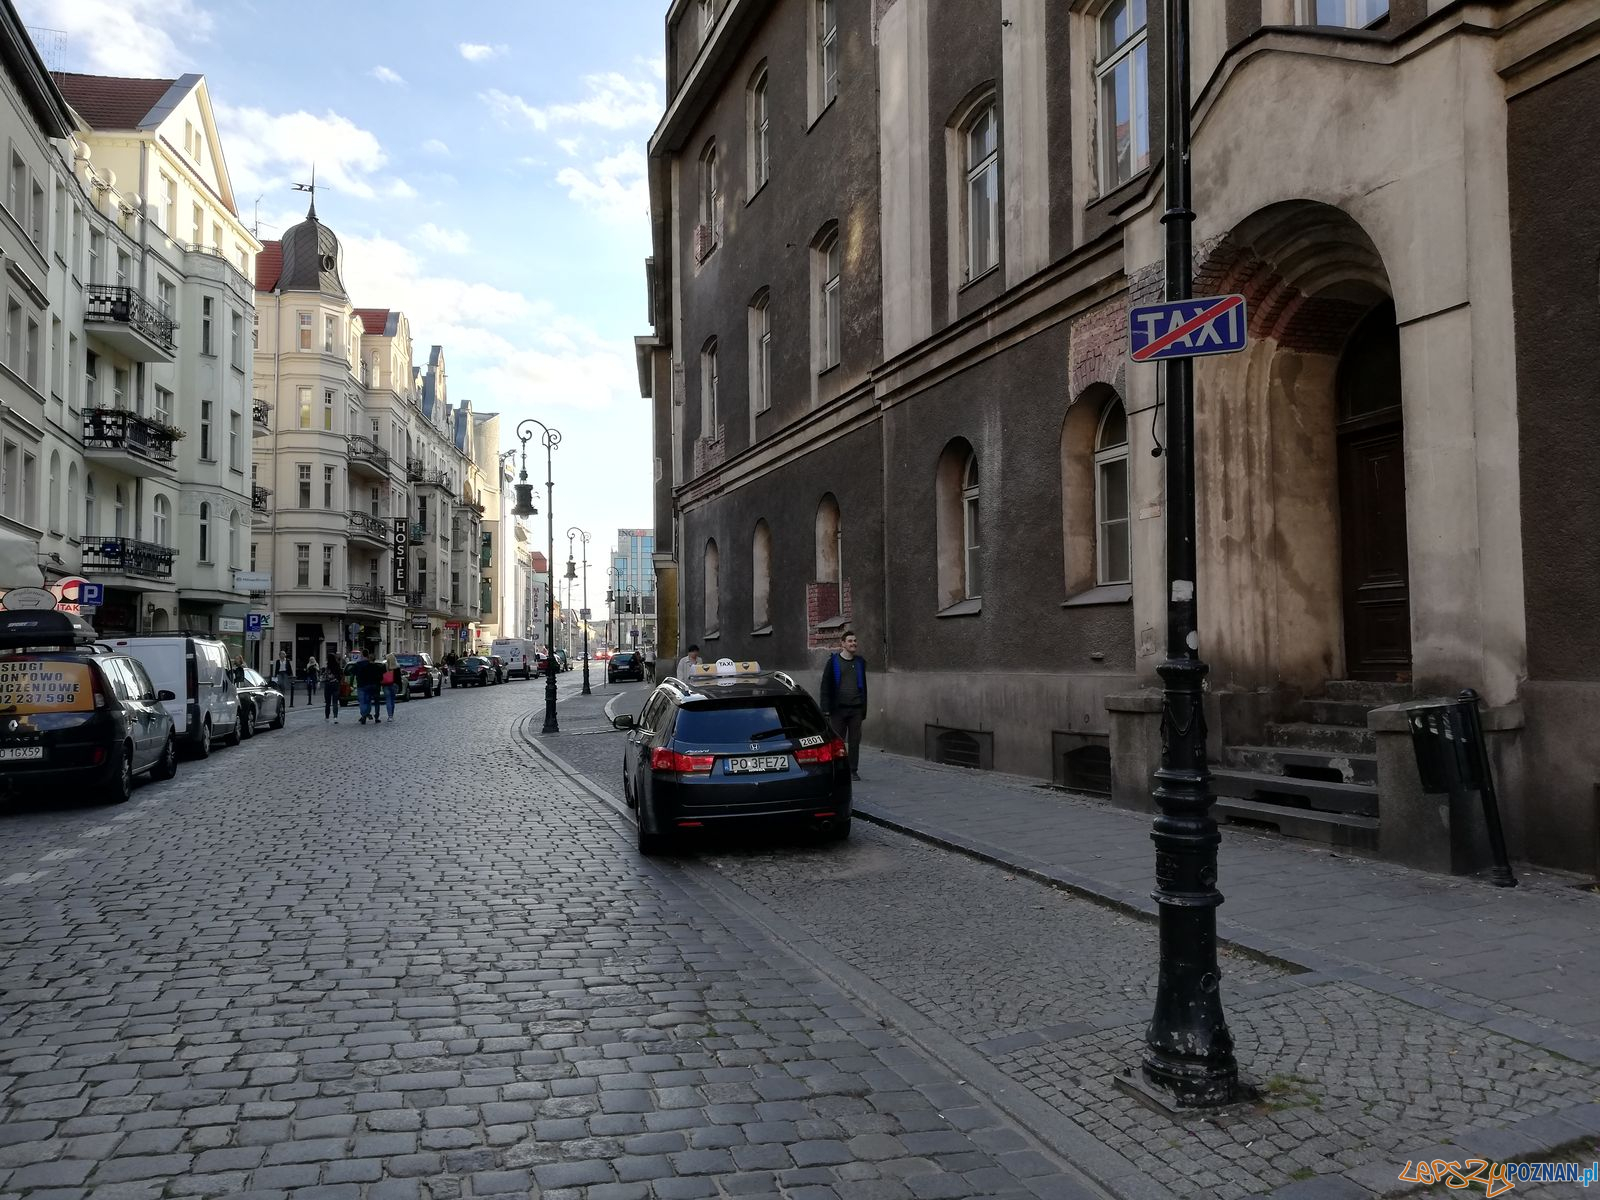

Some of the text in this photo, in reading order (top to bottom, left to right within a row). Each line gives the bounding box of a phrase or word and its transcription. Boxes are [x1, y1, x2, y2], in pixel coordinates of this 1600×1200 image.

[1137, 306, 1238, 350] TAXI
[395, 522, 406, 591] HOSTEL
[83, 585, 98, 603] P
[249, 615, 259, 627] P
[0, 693, 75, 704] 2 237 599
[801, 737, 823, 746] 2801
[10, 747, 40, 758] 1GX59
[730, 759, 748, 770] PO
[751, 756, 787, 769] 3FE72
